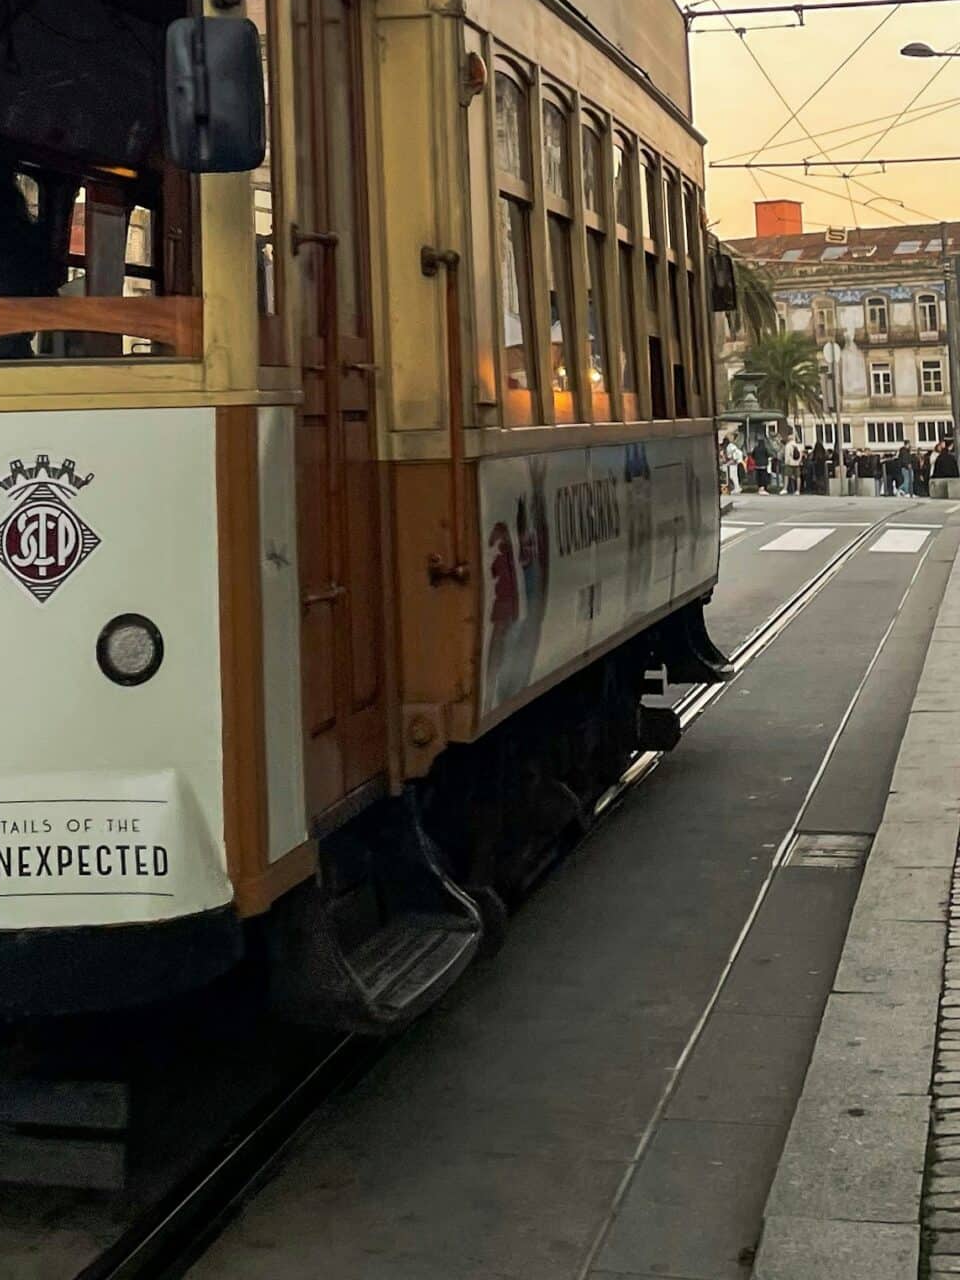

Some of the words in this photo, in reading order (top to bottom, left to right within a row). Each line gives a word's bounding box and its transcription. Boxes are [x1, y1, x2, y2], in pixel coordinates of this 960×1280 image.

[0, 818, 53, 835] TAILS
[65, 818, 94, 833] OF
[106, 818, 142, 833] THE
